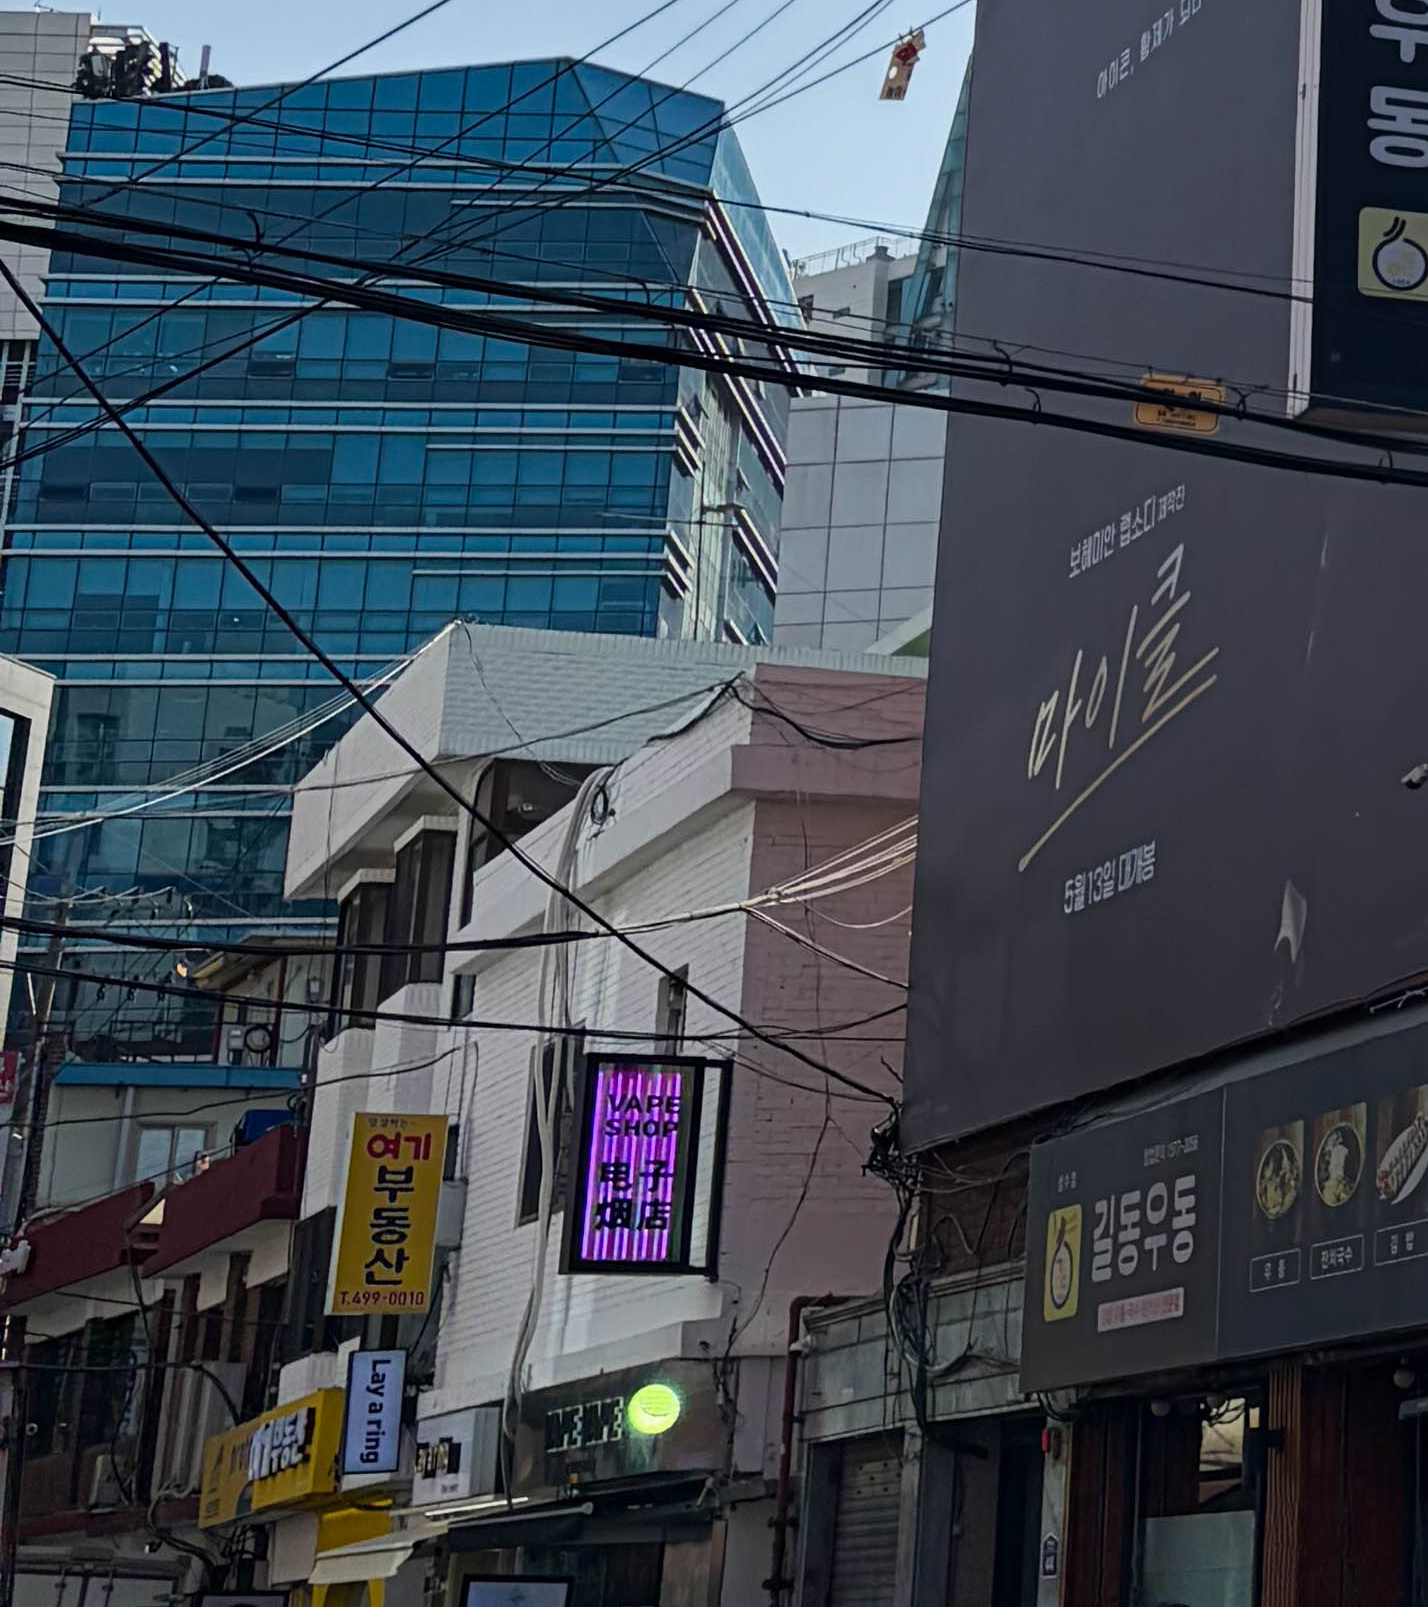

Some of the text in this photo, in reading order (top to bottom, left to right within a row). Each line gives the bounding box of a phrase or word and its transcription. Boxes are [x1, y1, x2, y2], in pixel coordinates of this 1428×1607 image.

[1068, 483, 1187, 580] 보헤미안 랩소디 제작진
[1027, 542, 1221, 791] 마이클
[1063, 839, 1156, 914] 5월 13일 대개봉
[609, 1094, 681, 1114] VAPE
[367, 1132, 432, 1161] 여기
[605, 1118, 679, 1137] SHOP
[364, 1165, 415, 1286] 부동산
[1091, 1173, 1197, 1283] 길동우동
[339, 1290, 425, 1306] T.499-0010
[366, 1359, 392, 1399] Lay
[359, 1424, 386, 1464] ring
